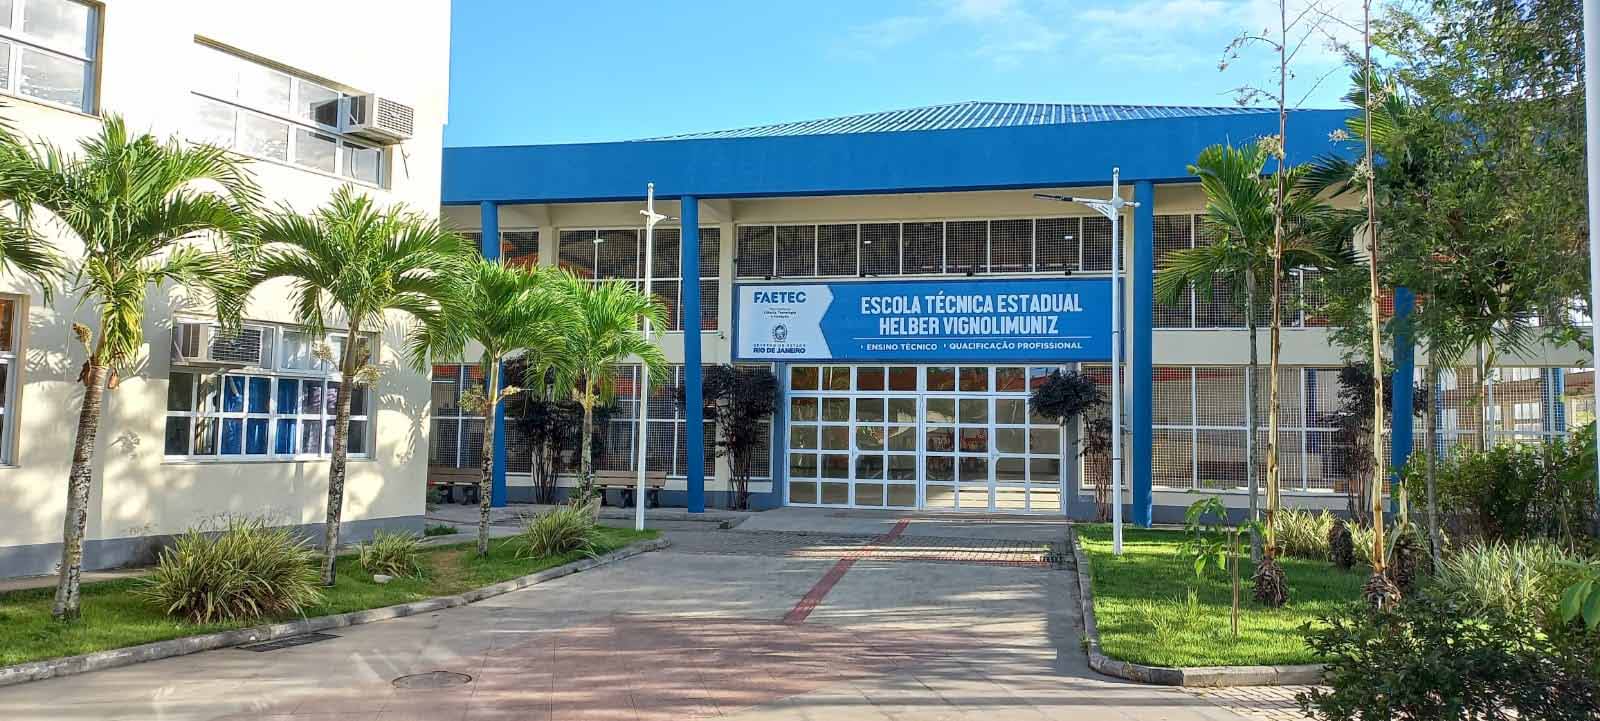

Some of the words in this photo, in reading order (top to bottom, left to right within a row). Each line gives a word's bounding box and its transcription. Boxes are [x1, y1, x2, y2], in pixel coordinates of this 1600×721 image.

[753, 291, 807, 304] FAETEC
[861, 295, 921, 315] ESCOLA
[925, 290, 993, 314] TÉCNICA
[997, 293, 1083, 313] ESTADUAL
[879, 317, 940, 336] HELBER
[942, 315, 1059, 335] VIGNOLIMUNIZ
[866, 343, 899, 351] ENSINO
[901, 341, 938, 351] TÉCNICO
[949, 341, 1016, 351] QUALIFICAÇÃO
[1017, 342, 1083, 350] PROFISSIONAL
